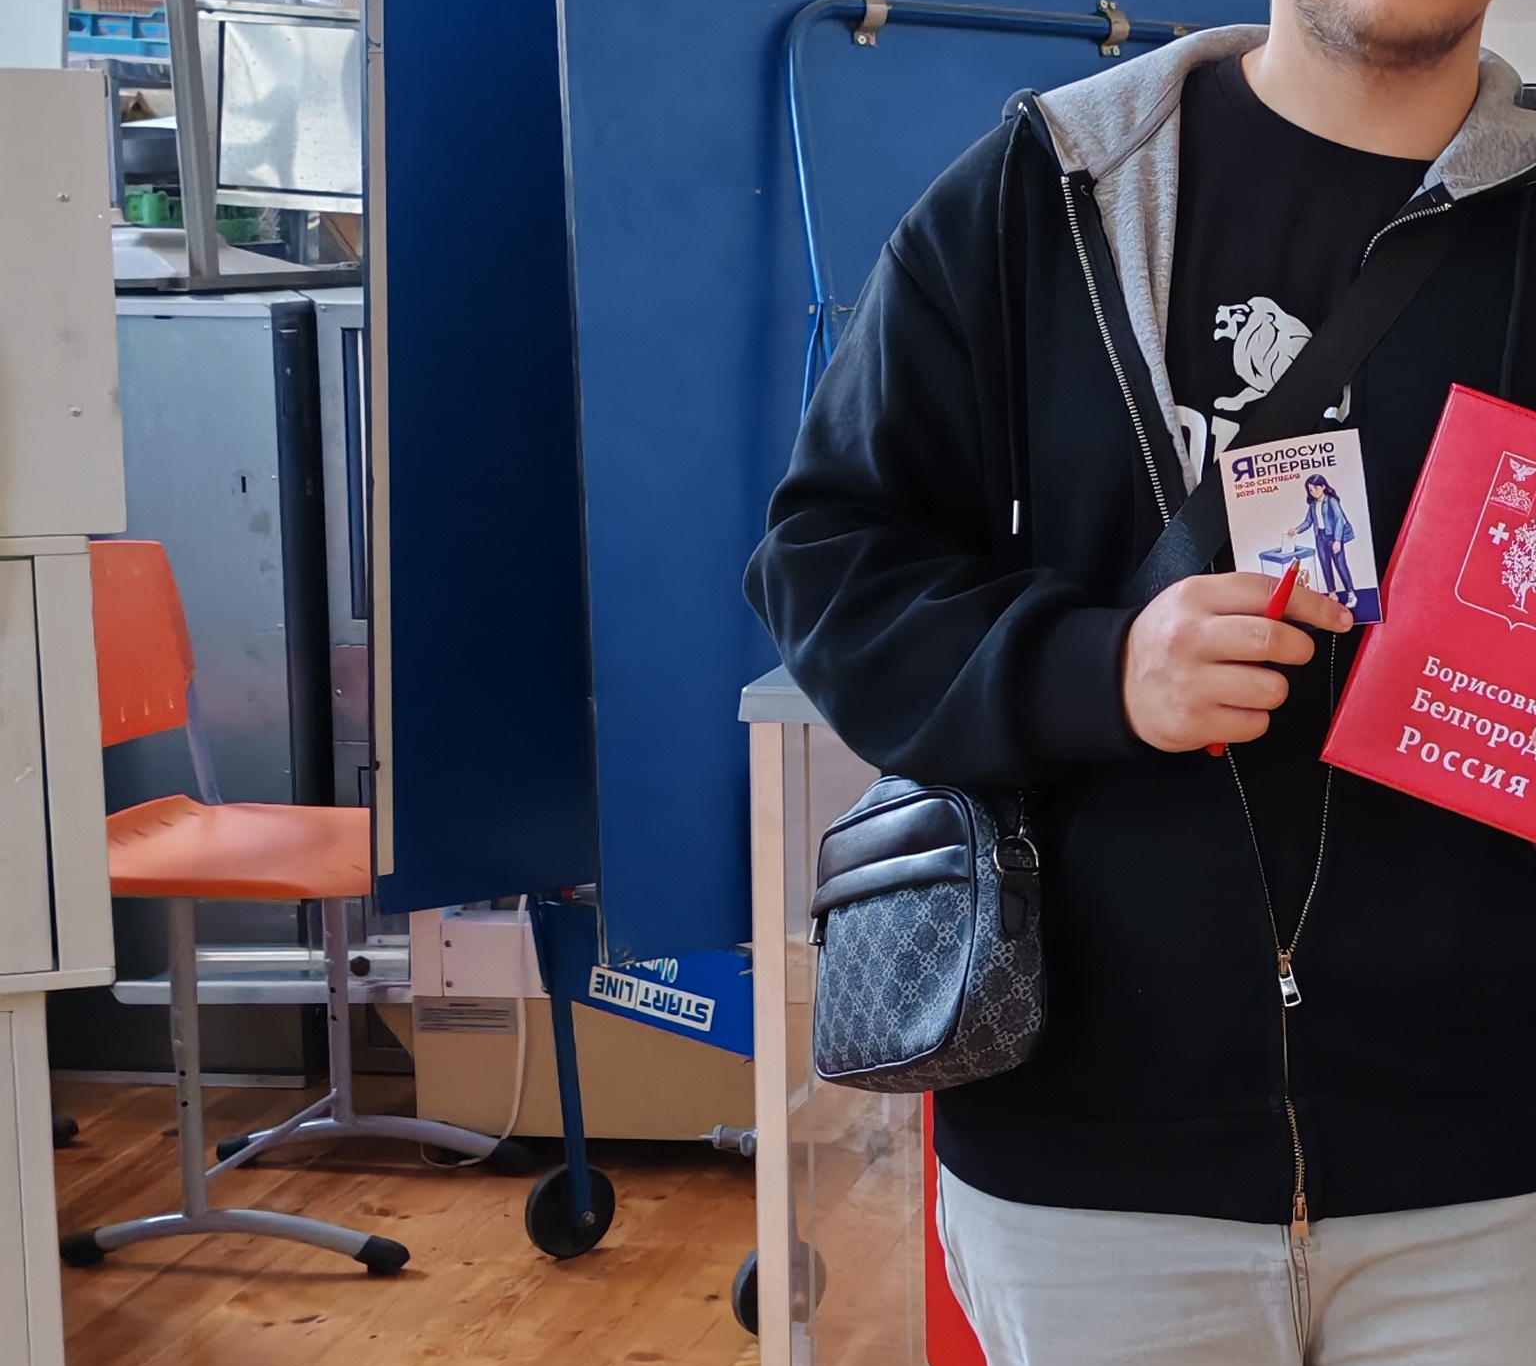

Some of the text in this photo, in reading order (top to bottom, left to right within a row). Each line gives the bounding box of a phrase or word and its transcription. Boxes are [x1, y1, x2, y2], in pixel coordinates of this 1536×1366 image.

[1231, 442, 1335, 482] Я ГОЛОСУЮ
[1256, 455, 1337, 478] ВПЕРВЫЕ
[1256, 485, 1279, 495] ГОДА
[1396, 725, 1530, 798] Россия
[594, 972, 710, 1024] START LINE
